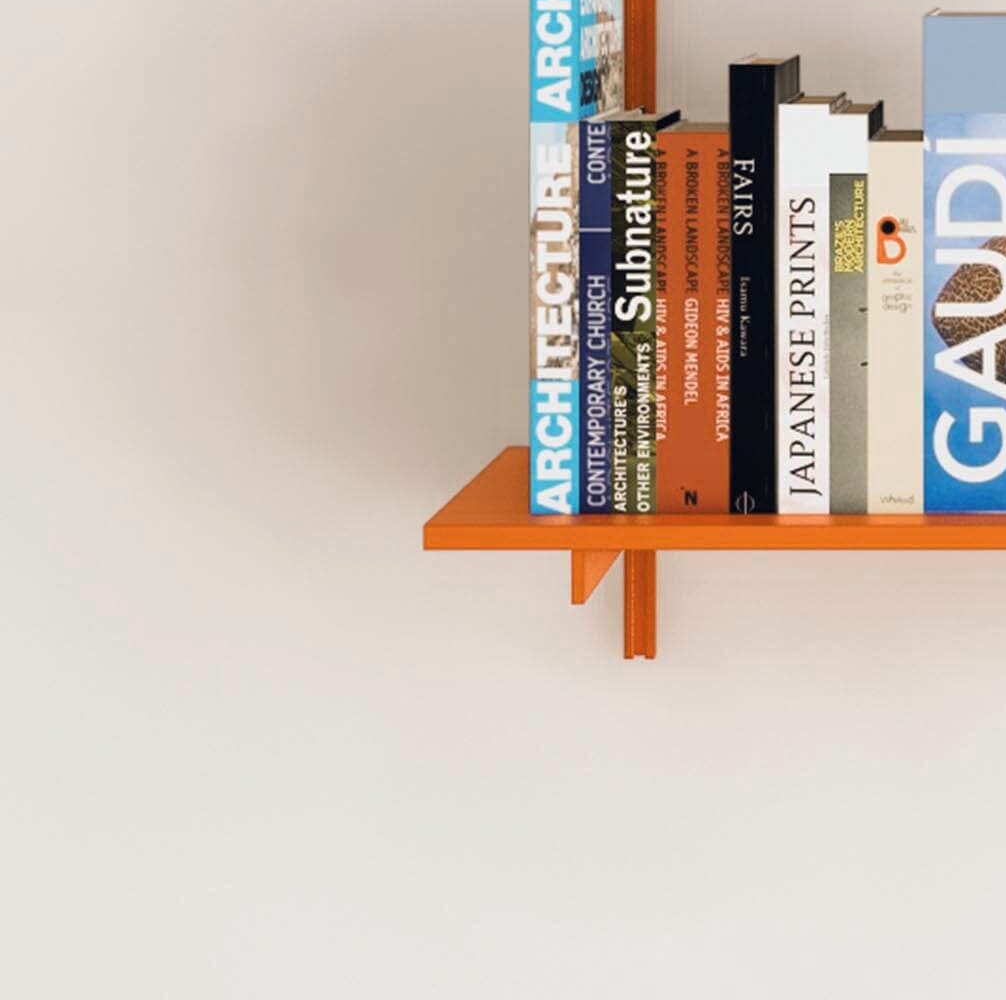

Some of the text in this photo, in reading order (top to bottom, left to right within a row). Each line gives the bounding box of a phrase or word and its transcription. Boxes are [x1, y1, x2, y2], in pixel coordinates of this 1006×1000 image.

[615, 131, 652, 323] Subnature
[684, 149, 699, 406] A BROKEN LANDSCAPE GIDEON MENDEL
[734, 158, 756, 236] FAIRS
[854, 180, 864, 273] ARCHITECTURE
[536, 143, 573, 514] ARCHITECTURE
[587, 275, 606, 508] CONTEMPORARY CHURCH
[716, 149, 730, 442] A BROKEN LANDSCAPE HIV & AIDS IN AFRICA
[740, 276, 751, 358] Isamu Kawara
[790, 197, 822, 496] JAPANESE PRINTS
[614, 385, 627, 513] ARCHITECTURE'S
[637, 343, 651, 513] OTHER ENVIRONMENTS
